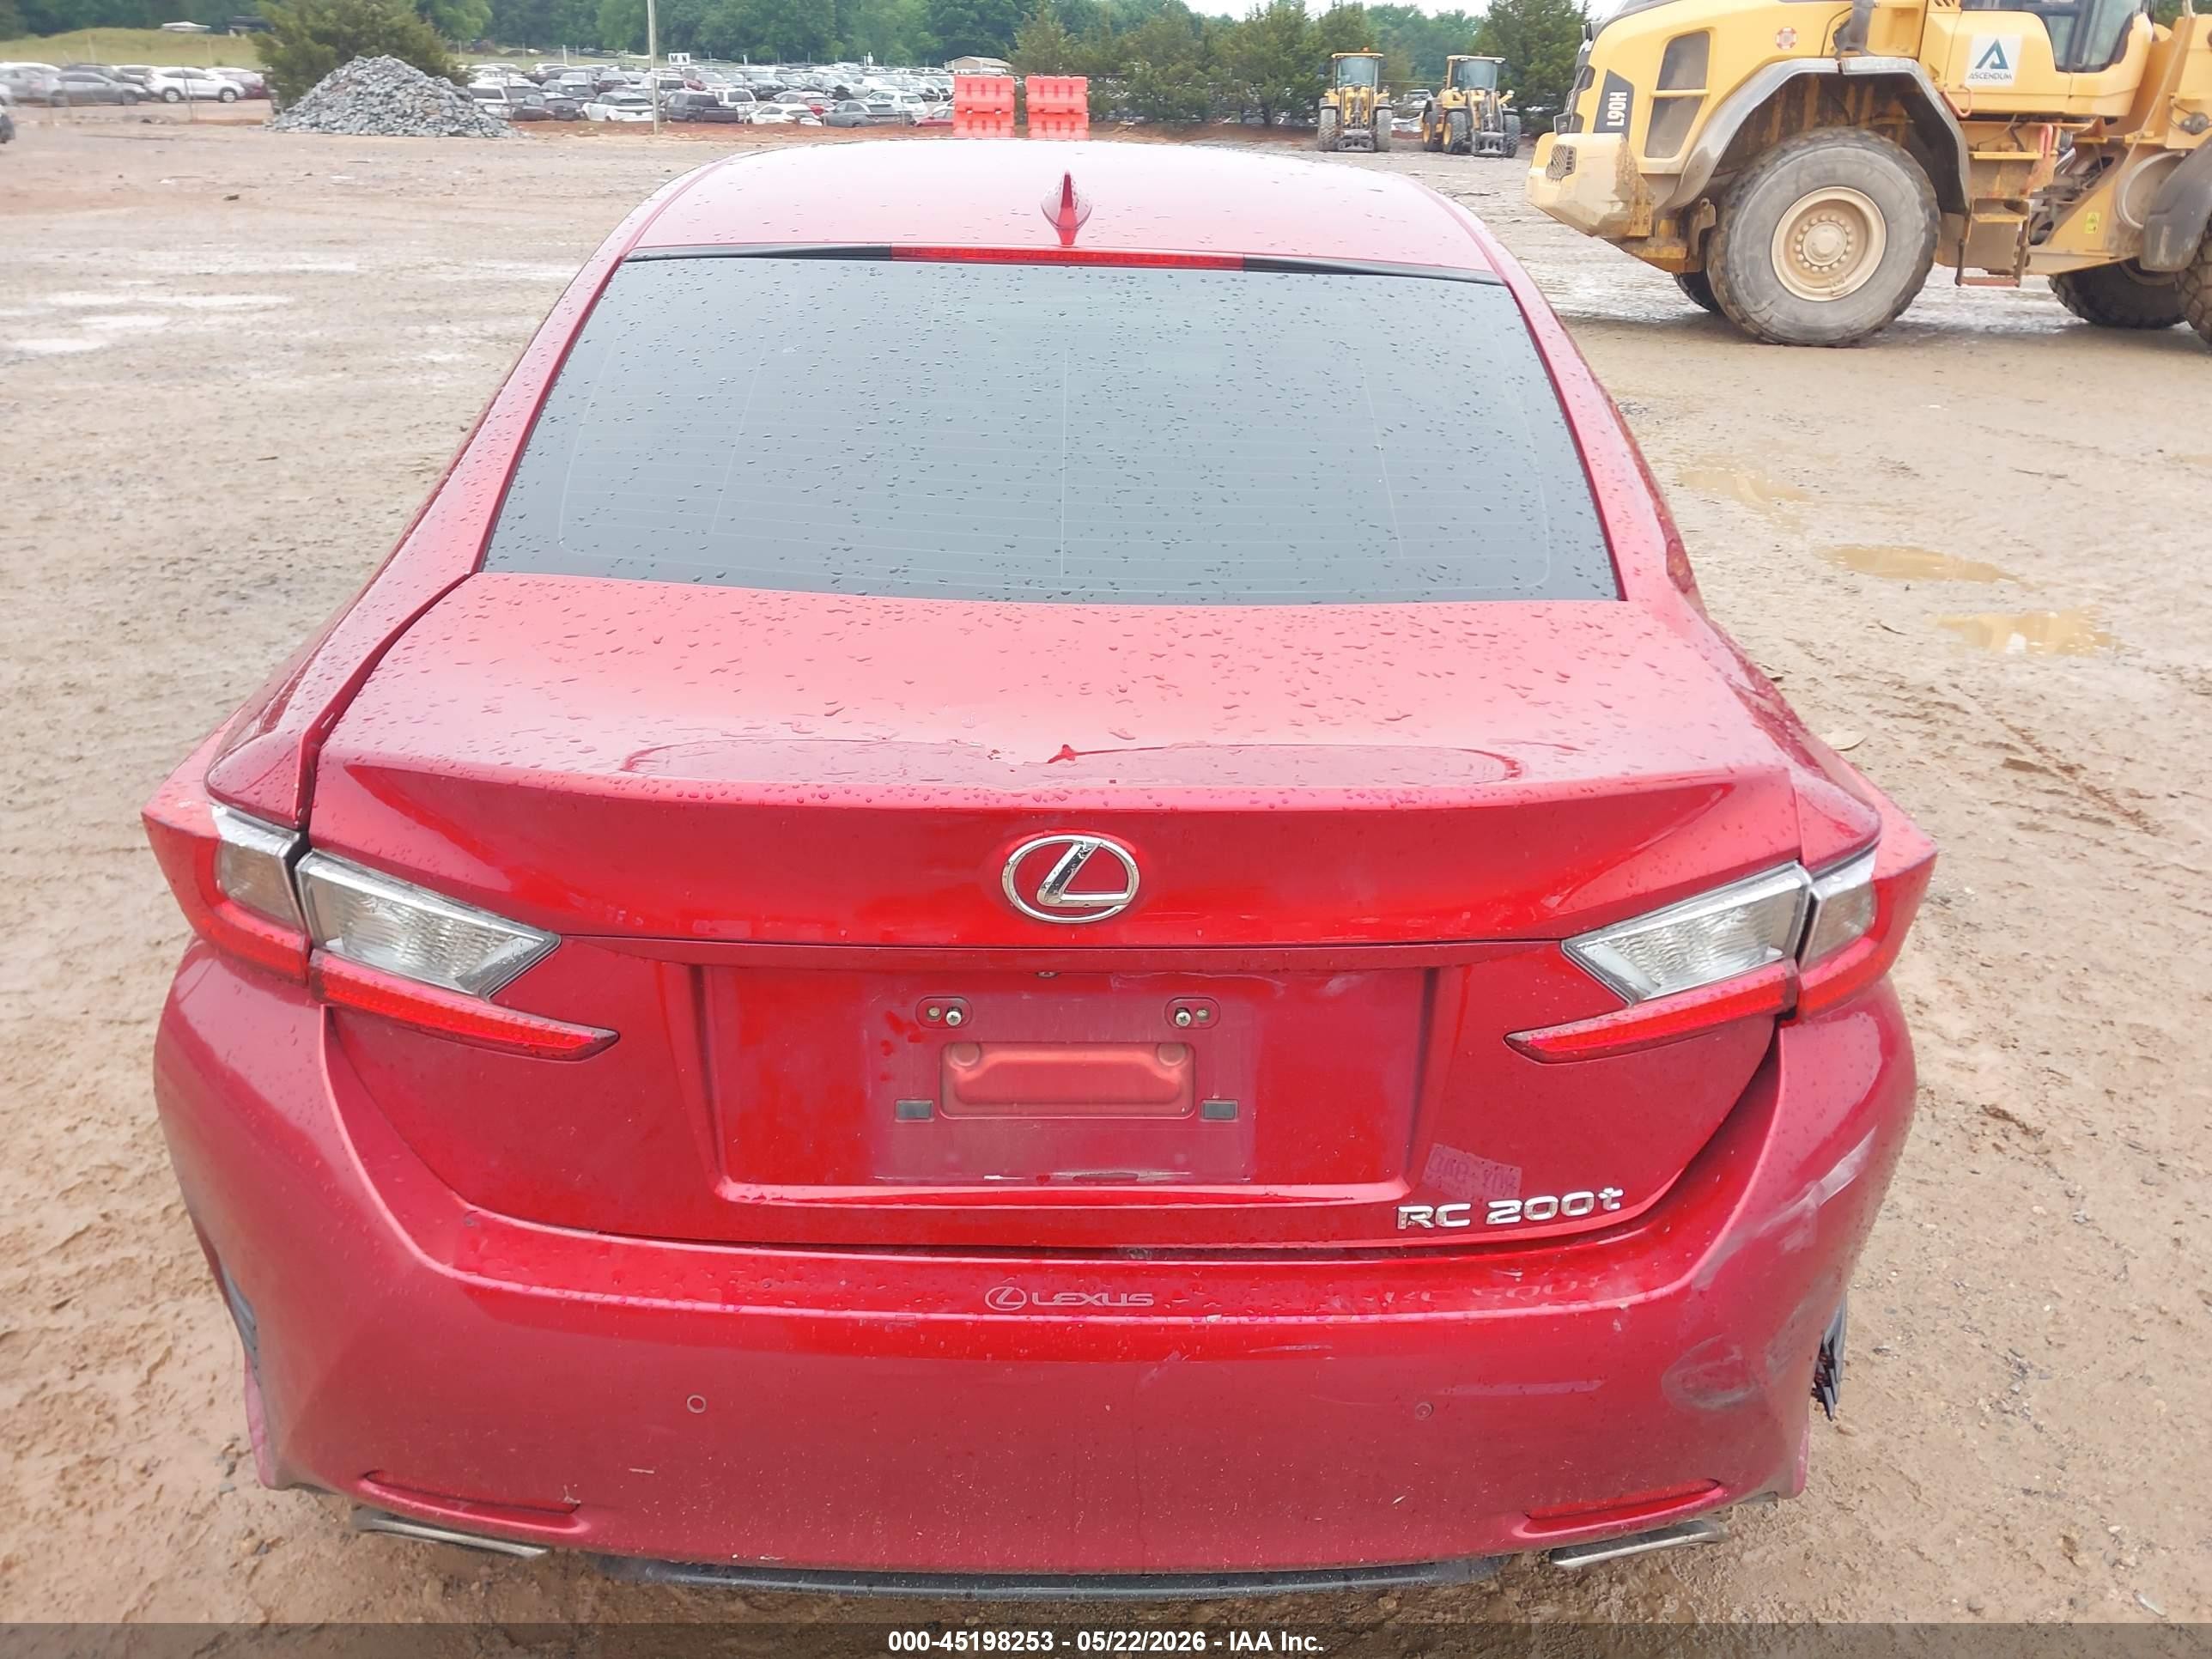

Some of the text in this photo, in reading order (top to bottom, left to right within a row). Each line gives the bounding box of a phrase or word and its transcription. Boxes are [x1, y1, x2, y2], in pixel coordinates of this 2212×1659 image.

[1967, 71, 2013, 81] ASCENDUM
[1607, 91, 1628, 126] L90H
[1396, 1187, 1625, 1230] RC 200t
[1031, 1291, 1154, 1307] LEXUS
